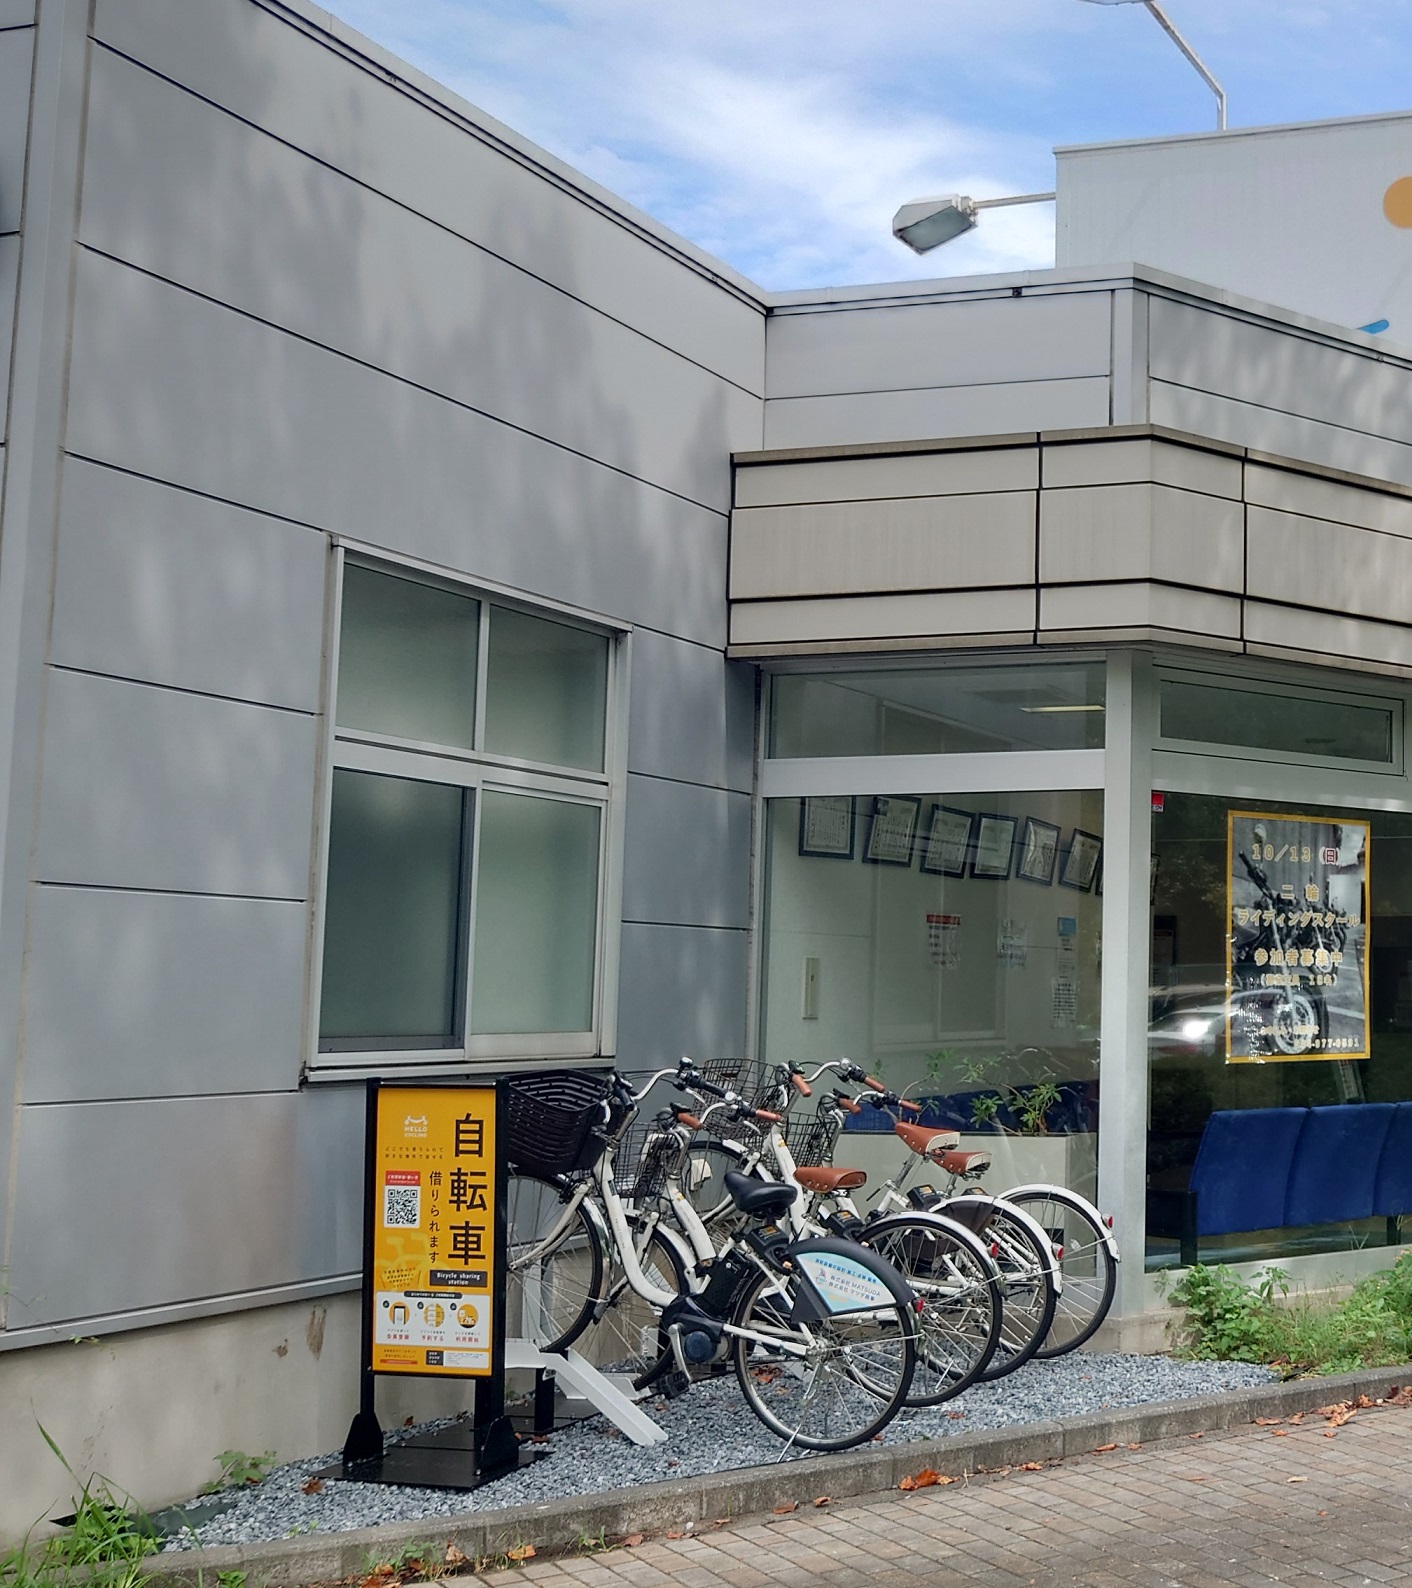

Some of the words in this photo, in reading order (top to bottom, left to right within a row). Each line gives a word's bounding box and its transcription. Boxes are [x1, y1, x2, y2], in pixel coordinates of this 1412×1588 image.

[1238, 909, 1361, 929] ライディングスクール
[1254, 948, 1342, 967] 参加者募集中
[448, 1113, 488, 1266] 自転車
[428, 1170, 443, 1264] 借りられます
[436, 1272, 457, 1280] Bicycle
[459, 1273, 481, 1281] sharing
